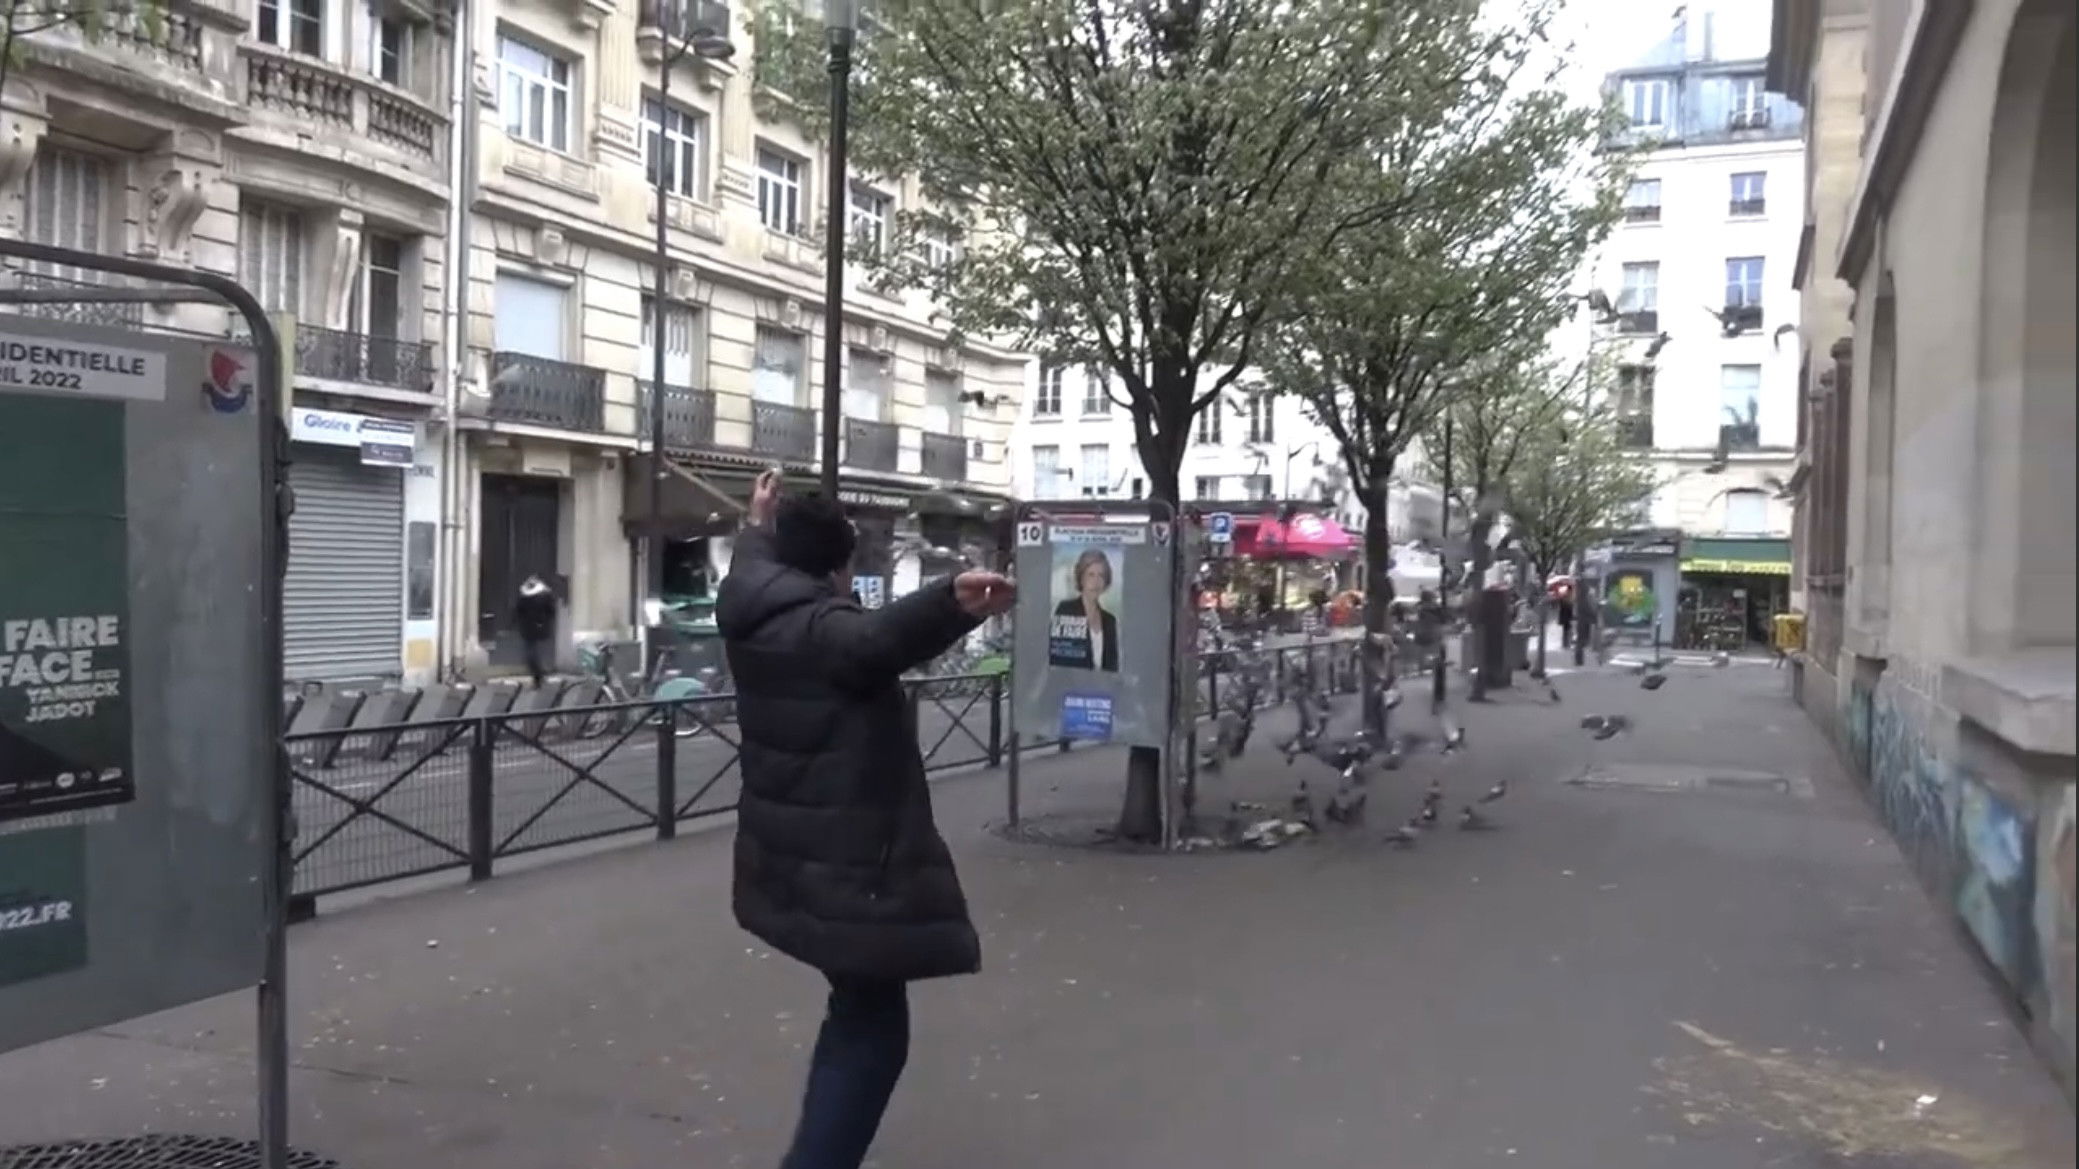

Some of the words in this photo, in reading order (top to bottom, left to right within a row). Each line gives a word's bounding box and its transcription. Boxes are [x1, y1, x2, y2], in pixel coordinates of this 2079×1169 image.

[0, 341, 146, 376] IDENTIELLE
[0, 366, 22, 384] IL
[30, 369, 82, 390] 2022
[1020, 526, 1041, 541] 10
[5, 615, 119, 652] FAIRE
[0, 650, 93, 687] FACE
[25, 700, 96, 722] JADOT
